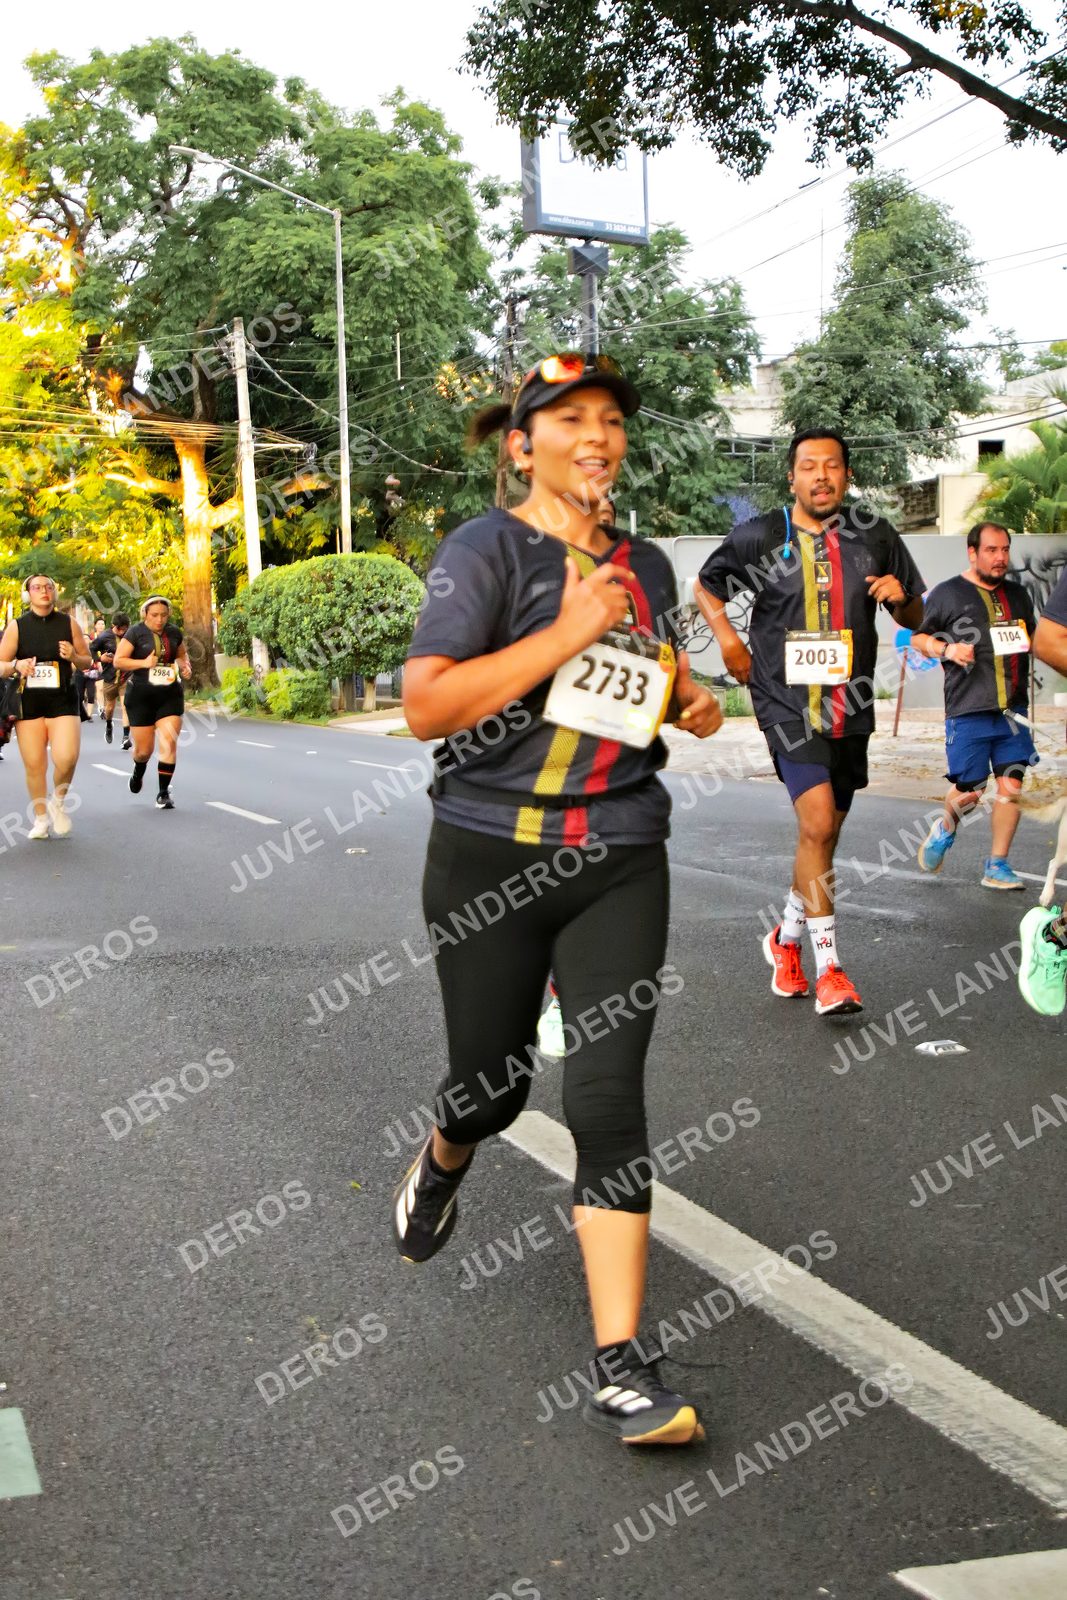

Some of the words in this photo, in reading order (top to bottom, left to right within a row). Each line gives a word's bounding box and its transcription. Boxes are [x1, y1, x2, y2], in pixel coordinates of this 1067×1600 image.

[998, 631, 1021, 642] 1104
[795, 649, 838, 665] 2003
[31, 669, 53, 678] 255
[153, 669, 171, 677] 2984
[573, 655, 649, 705] 2733
